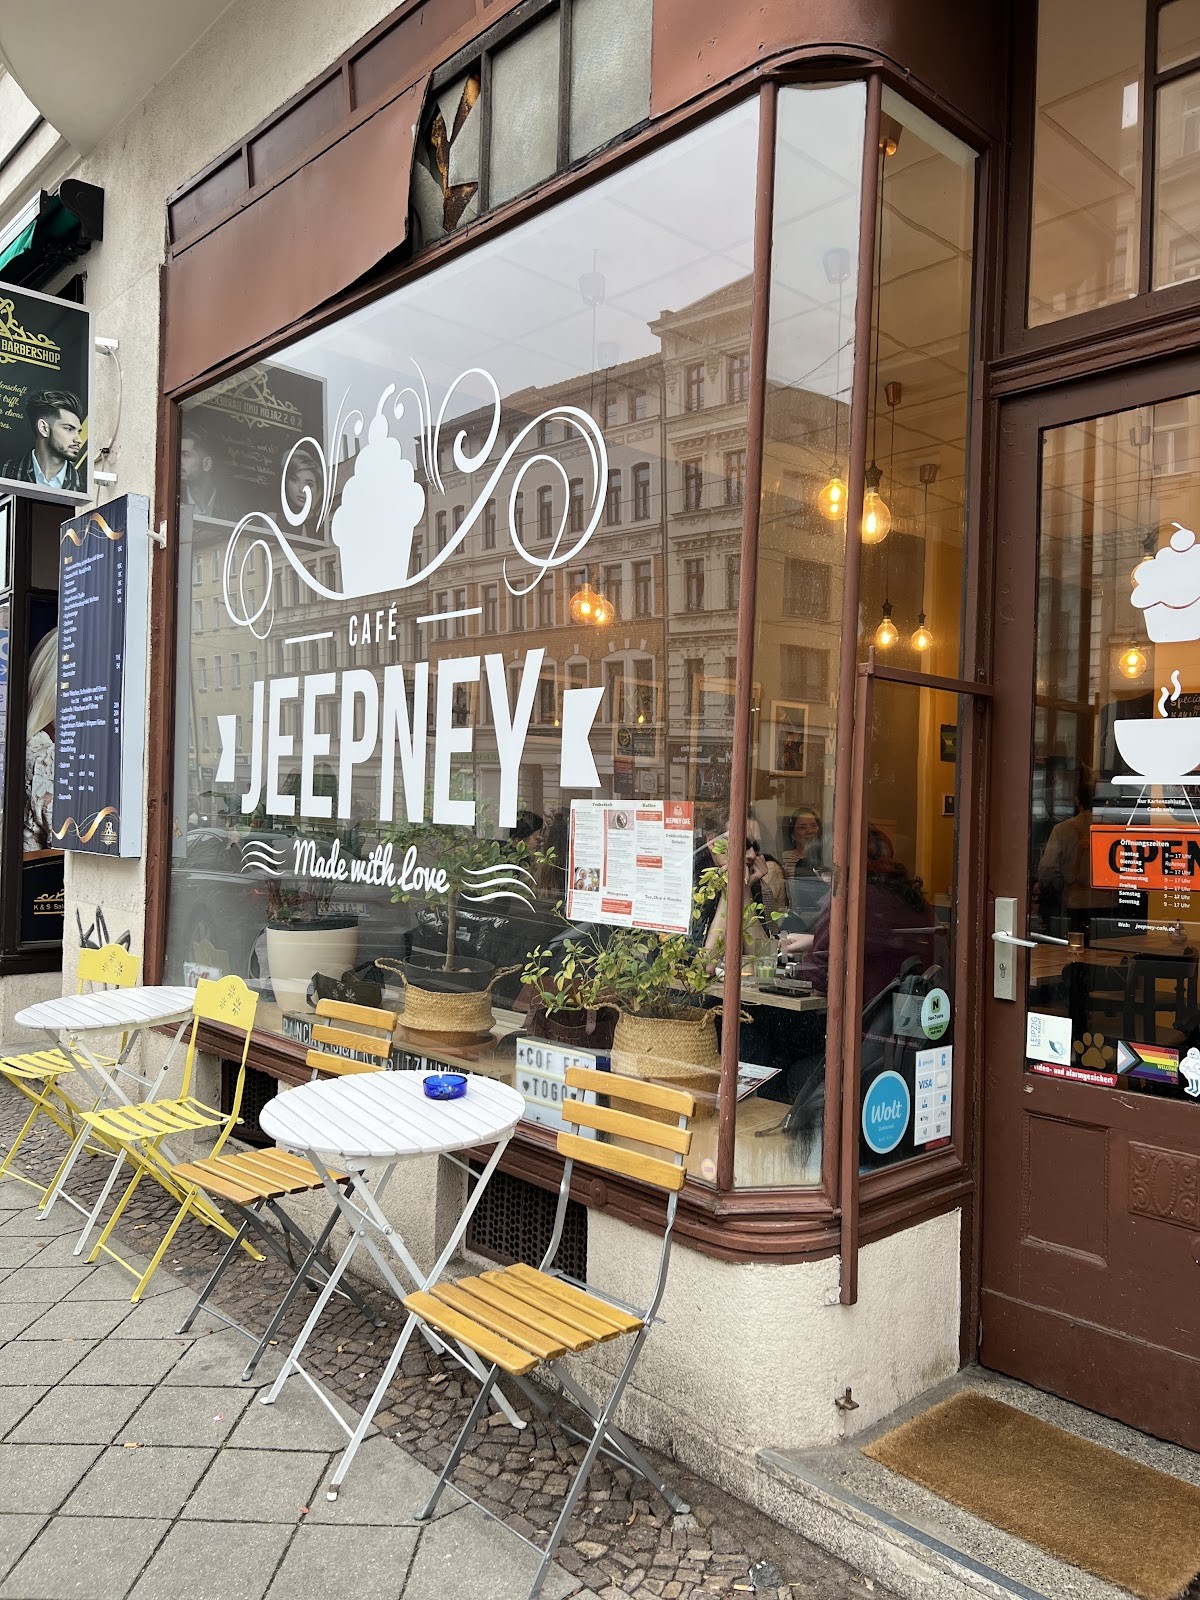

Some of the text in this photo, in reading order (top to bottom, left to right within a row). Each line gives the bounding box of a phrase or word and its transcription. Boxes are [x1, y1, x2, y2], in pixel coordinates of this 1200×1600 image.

[1, 339, 60, 364] BARBERSHOP
[349, 602, 397, 646] CAFÉ
[241, 648, 545, 828] JEEPNEY
[1120, 839, 1169, 848] Öffnungszeiten
[293, 838, 349, 881] Made
[351, 842, 396, 887] with
[918, 1079, 932, 1089] VISA
[1054, 1067, 1064, 1075] und
[1066, 1069, 1113, 1084] alarmgesichert
[871, 1099, 902, 1124] Wolt
